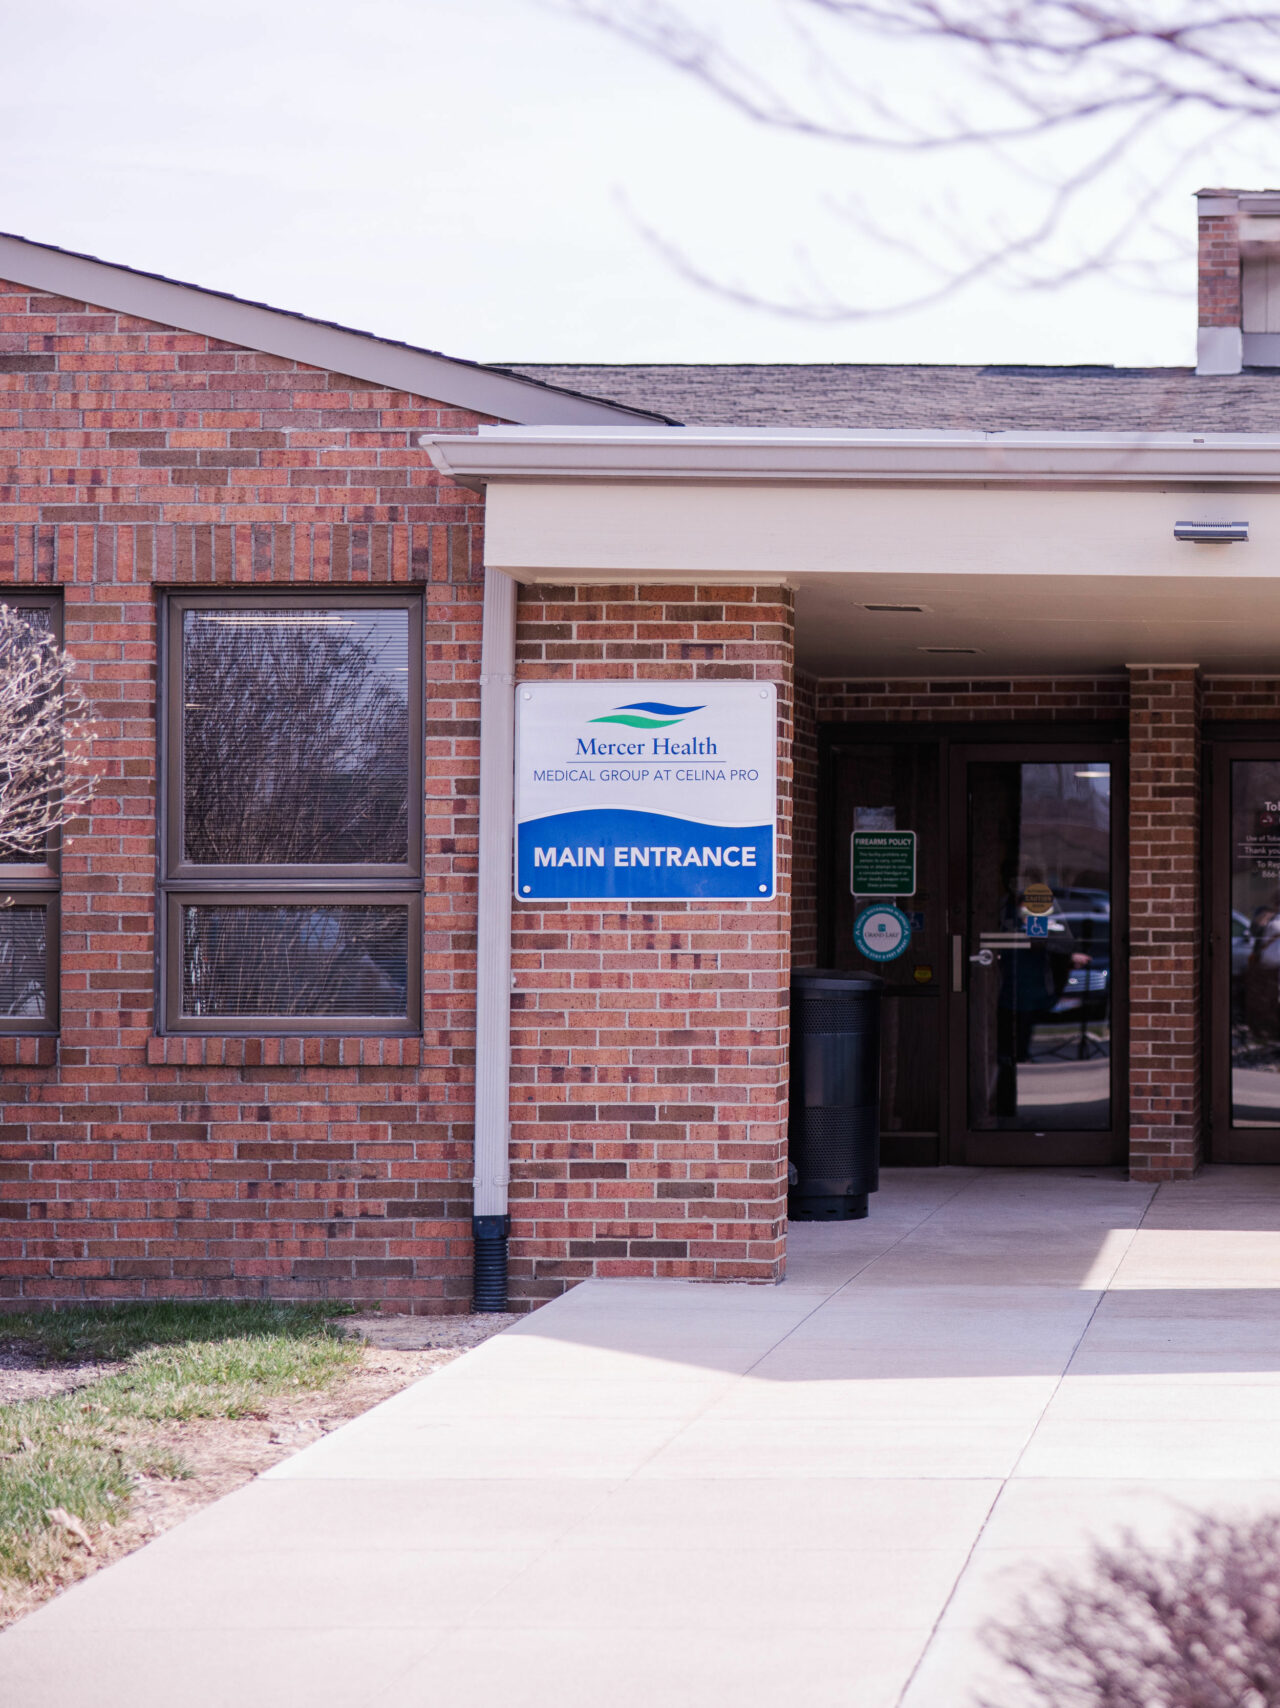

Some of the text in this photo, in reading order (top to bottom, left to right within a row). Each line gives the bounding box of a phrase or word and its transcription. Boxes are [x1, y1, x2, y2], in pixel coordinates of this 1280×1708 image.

[576, 736, 717, 755] Mercer Health
[533, 769, 759, 782] MEDICAL GROUP AT CELINA PRO
[534, 846, 757, 867] MAIN ENTRANCE
[1244, 846, 1266, 854] Thank
[1257, 860, 1266, 868] To
